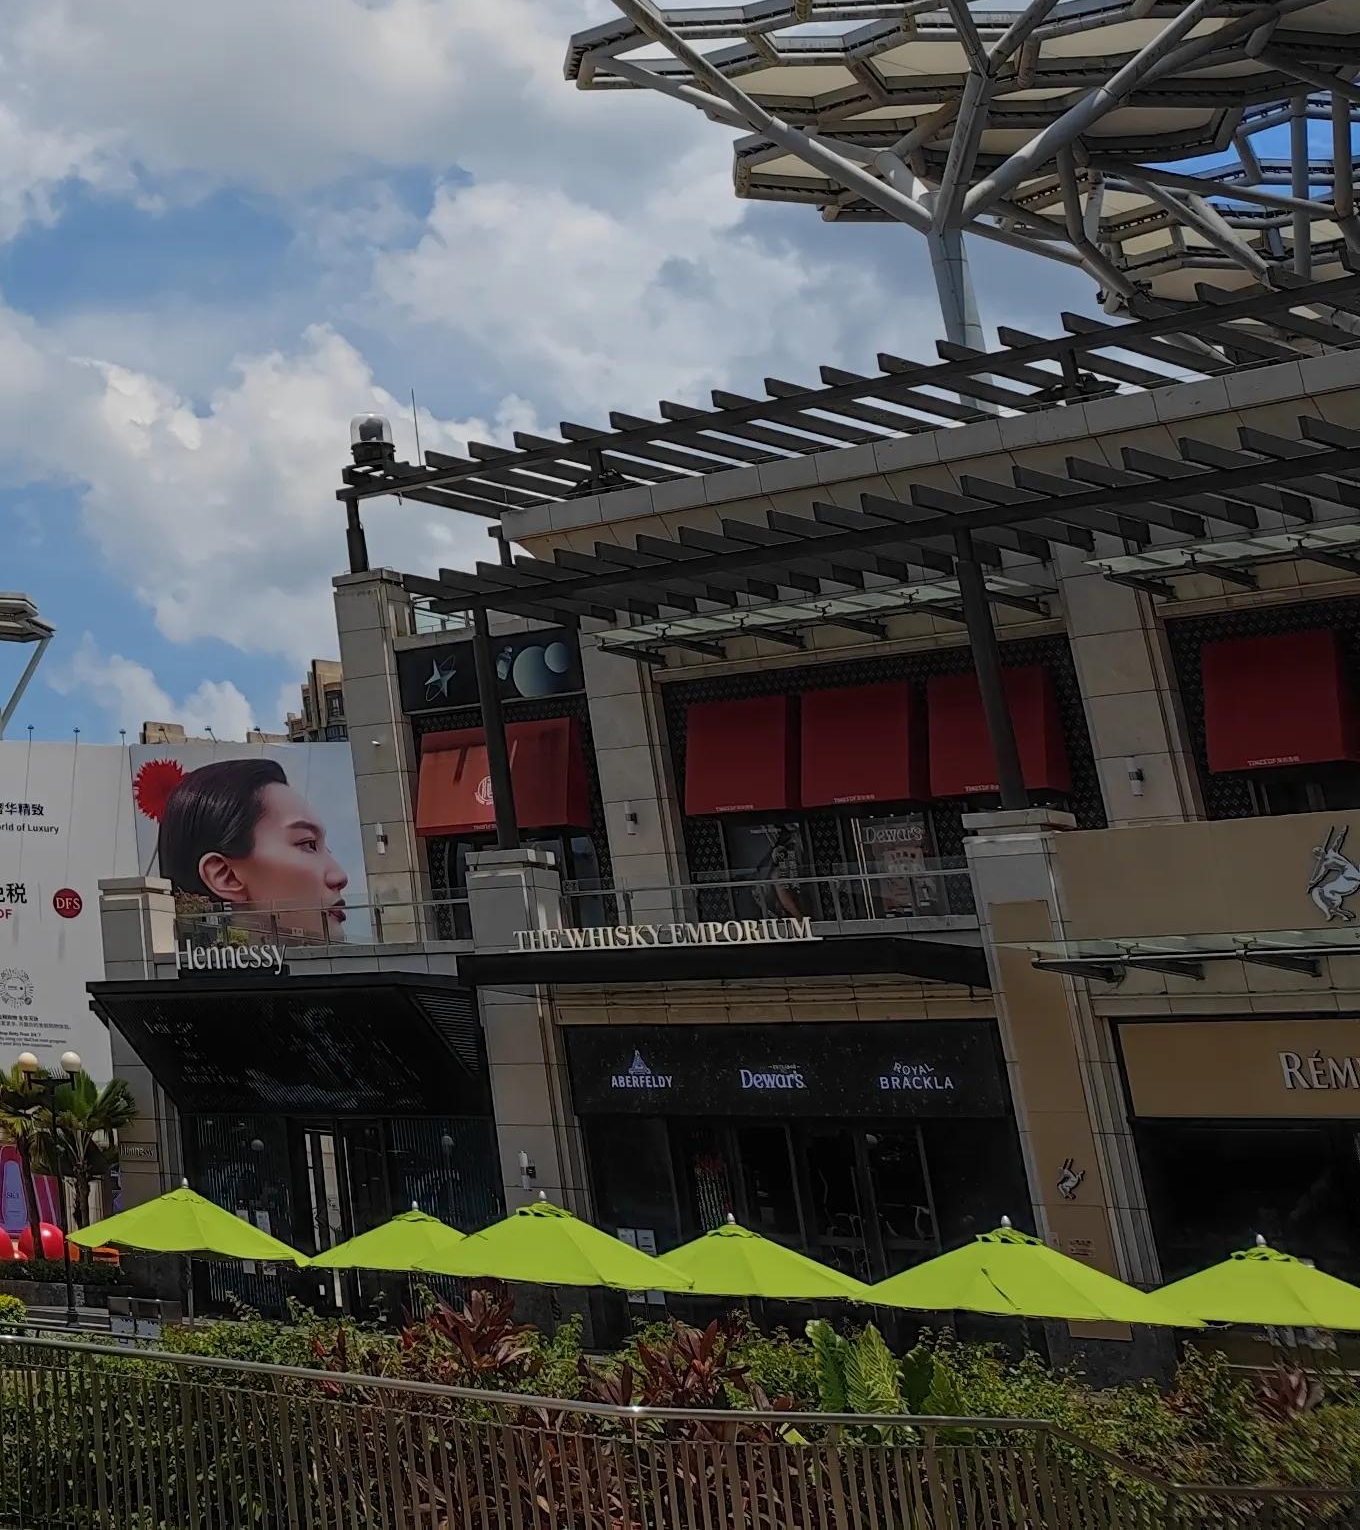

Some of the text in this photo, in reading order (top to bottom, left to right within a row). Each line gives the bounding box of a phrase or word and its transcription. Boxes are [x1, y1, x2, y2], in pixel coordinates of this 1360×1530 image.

[16, 823, 25, 831] of
[27, 824, 59, 834] Luxury
[55, 897, 80, 910] DFS
[512, 917, 815, 951] THE WHISKY EMPORIUM
[174, 938, 286, 976] Hennessy
[892, 1061, 936, 1075] ROYAL
[1277, 1049, 1360, 1090] RÉM
[610, 1075, 673, 1089] ABERFELDY
[738, 1070, 806, 1090] Dewar's
[879, 1076, 955, 1090] BRACKLA
